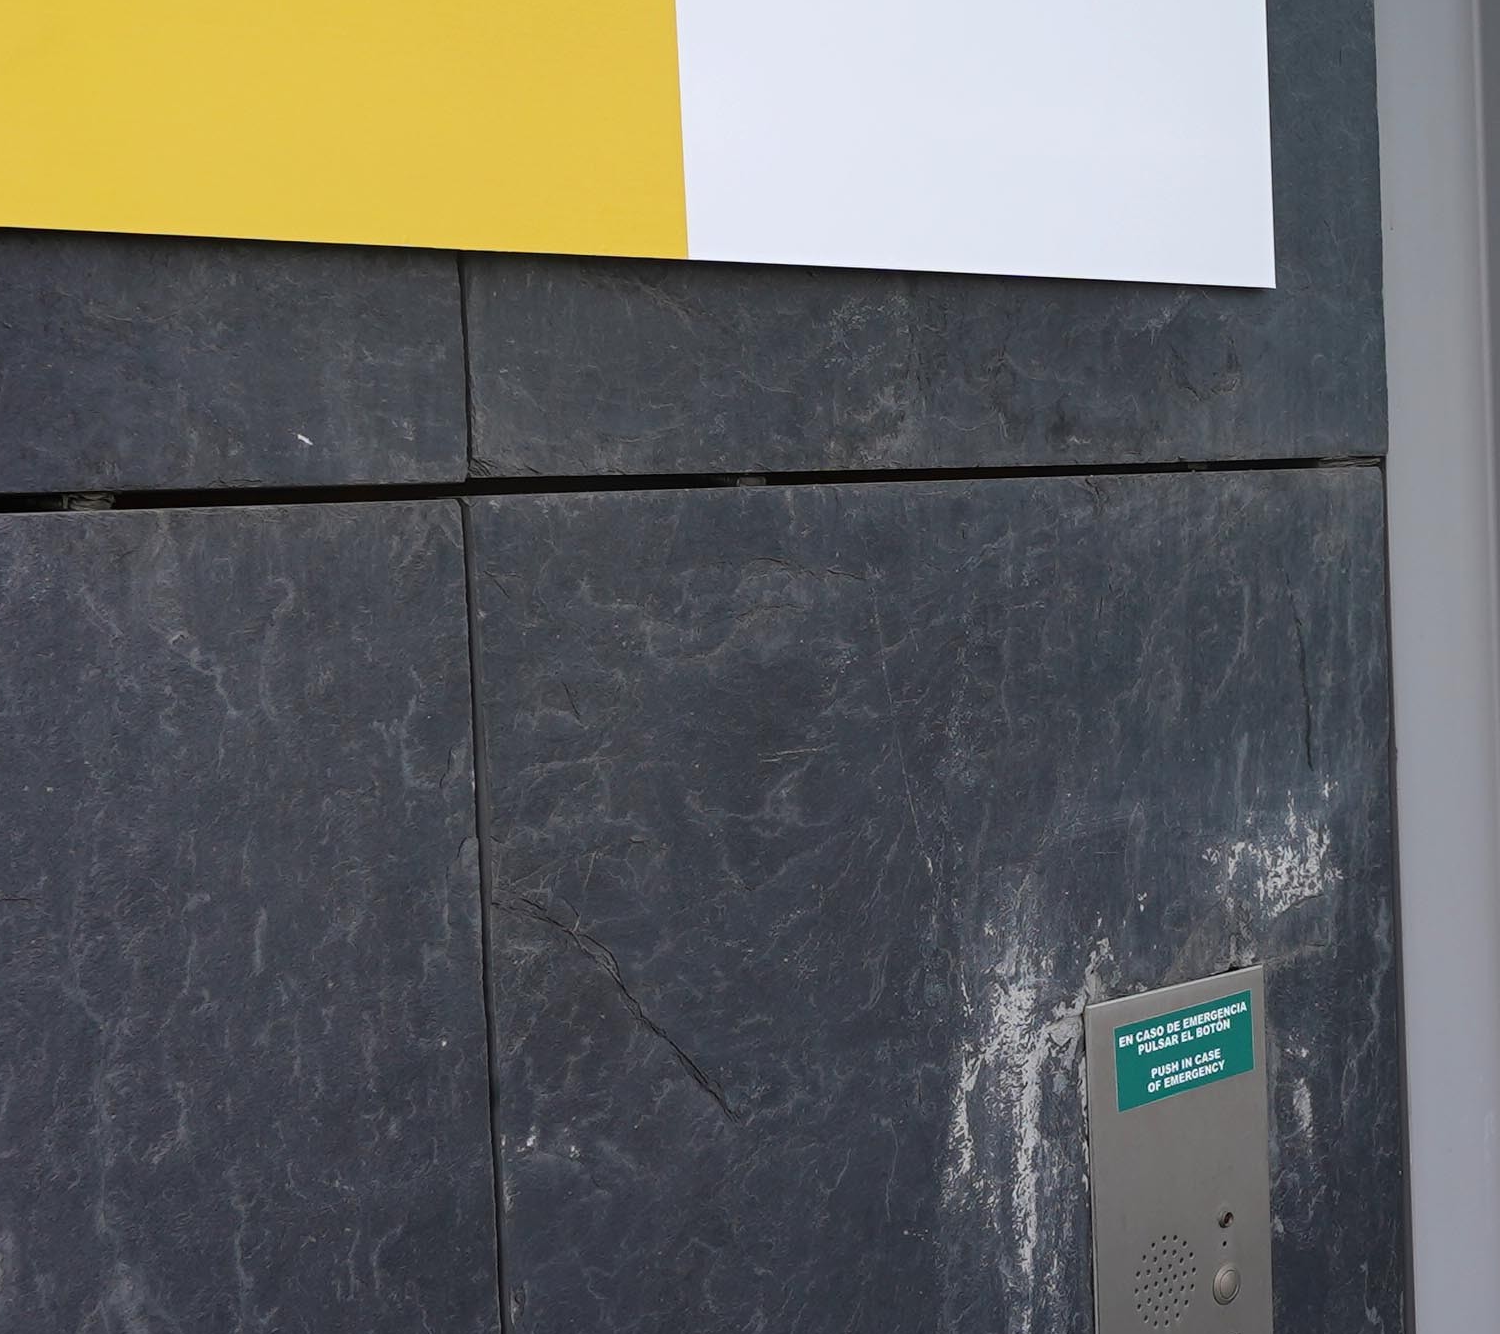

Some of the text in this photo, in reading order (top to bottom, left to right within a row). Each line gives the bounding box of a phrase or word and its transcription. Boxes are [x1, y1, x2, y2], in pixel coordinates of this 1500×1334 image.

[1118, 1001, 1247, 1048] EN CASO DE EMERGENCIA
[1137, 1017, 1231, 1055] PULSAR EL BOTÓN
[1147, 1059, 1225, 1094] OF EMERGENCY
[1151, 1048, 1221, 1079] PUSH IN CASE
